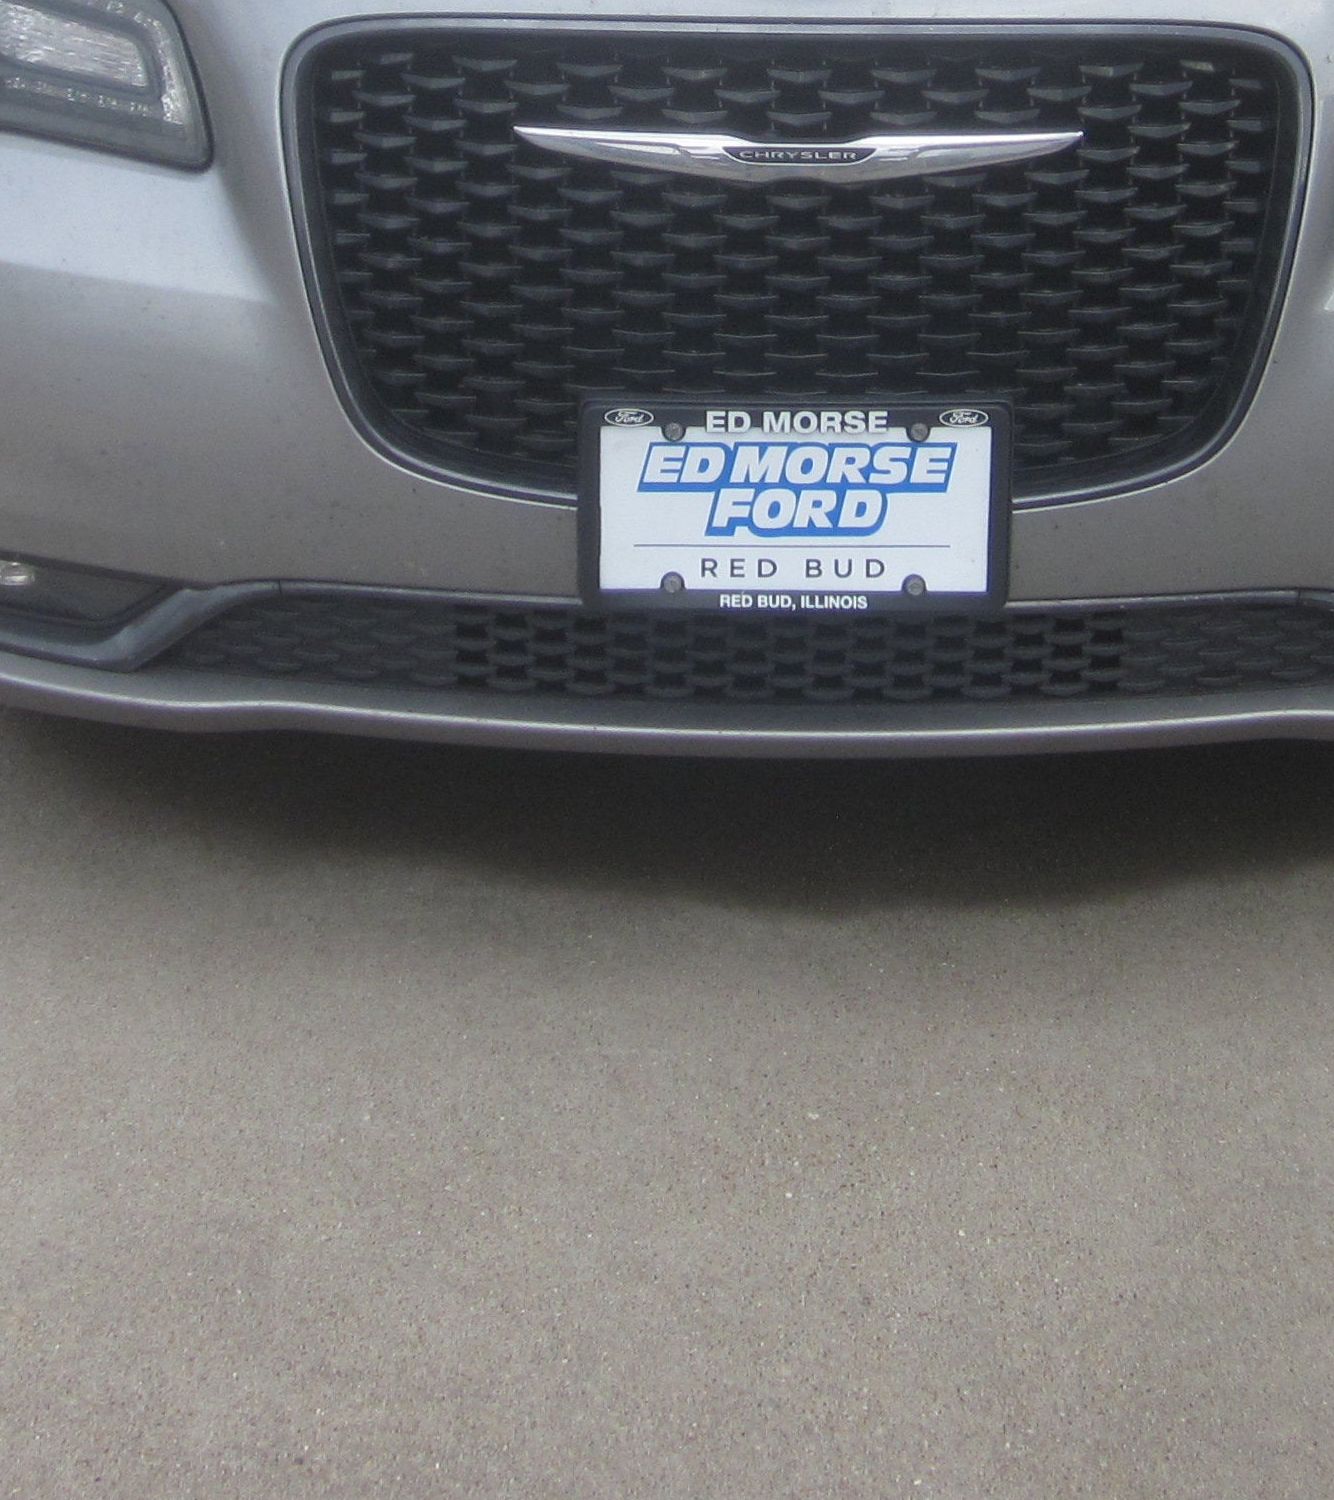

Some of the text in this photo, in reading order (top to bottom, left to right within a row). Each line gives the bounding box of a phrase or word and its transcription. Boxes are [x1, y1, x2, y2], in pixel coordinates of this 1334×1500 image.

[739, 150, 857, 160] CHRYSLER
[614, 411, 646, 424] Ford
[705, 410, 889, 435] ED MORSE
[949, 411, 979, 424] Ford
[641, 445, 954, 485] ED MORSE
[711, 487, 884, 530] FORD
[700, 557, 886, 579] RED BUD
[719, 593, 868, 611] RED BUD, ILLINOIS
